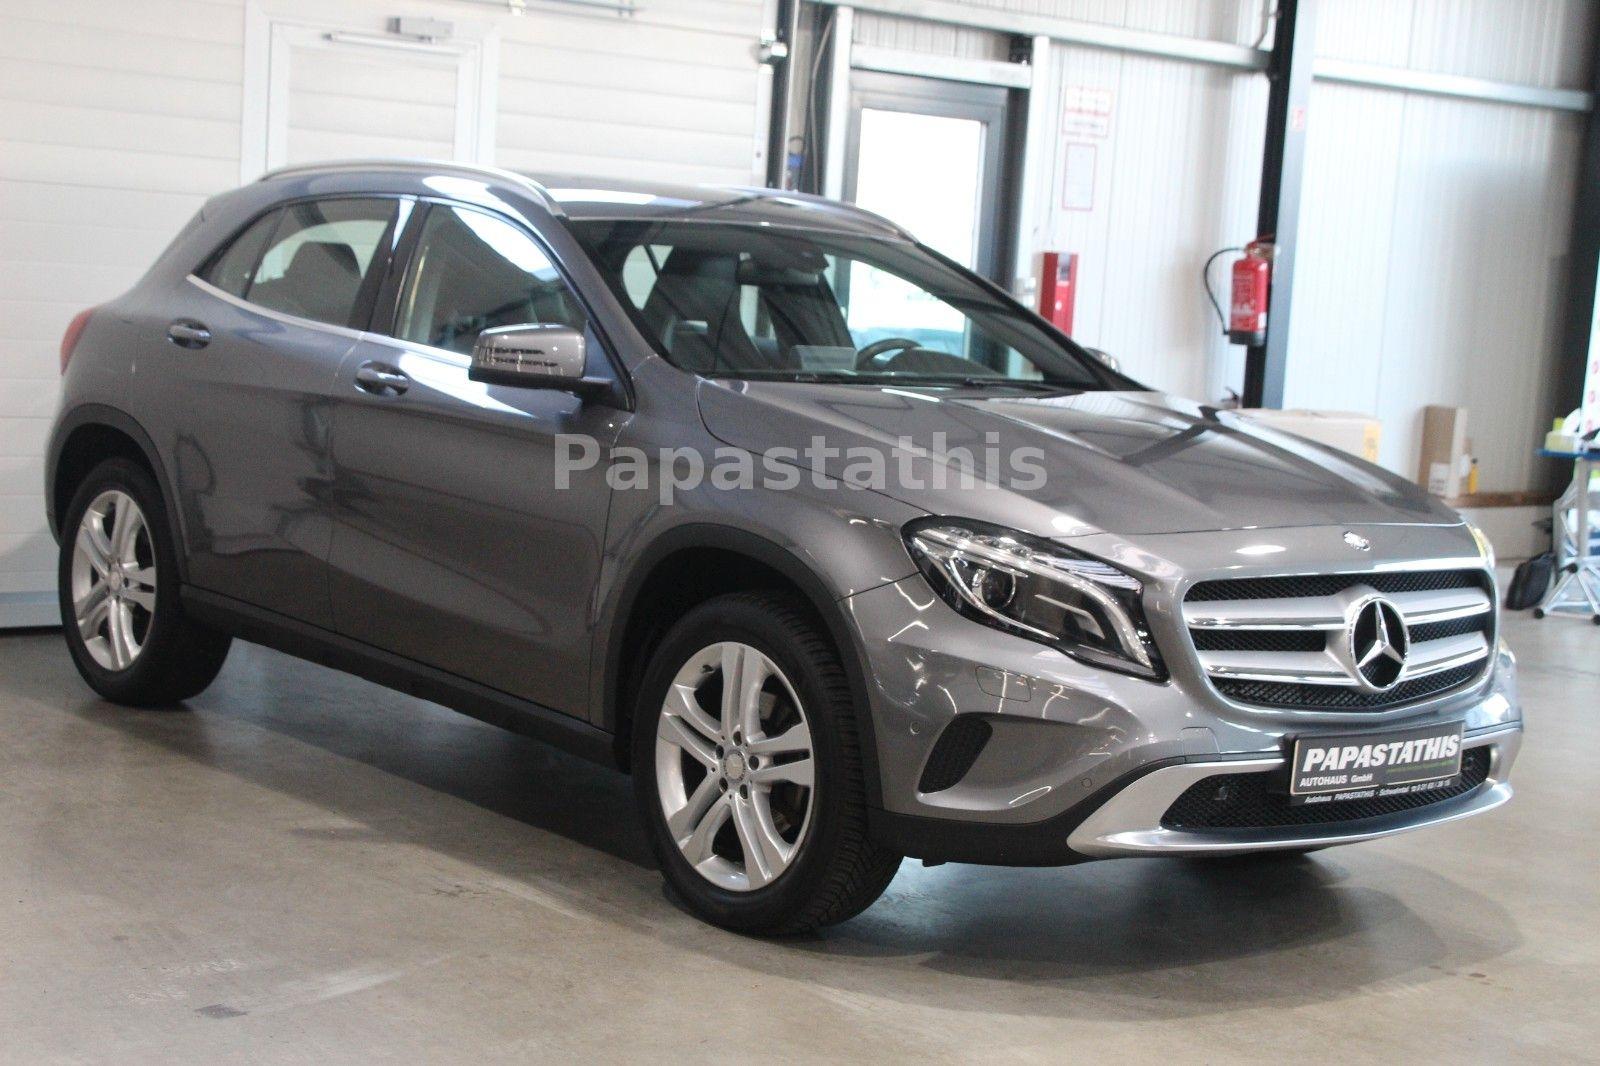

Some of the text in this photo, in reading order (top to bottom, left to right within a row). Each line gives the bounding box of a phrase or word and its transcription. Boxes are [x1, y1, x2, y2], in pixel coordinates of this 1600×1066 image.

[1302, 734, 1459, 772] PAPASTATHIS
[1299, 773, 1373, 787] AUTOHAUS GmbH
